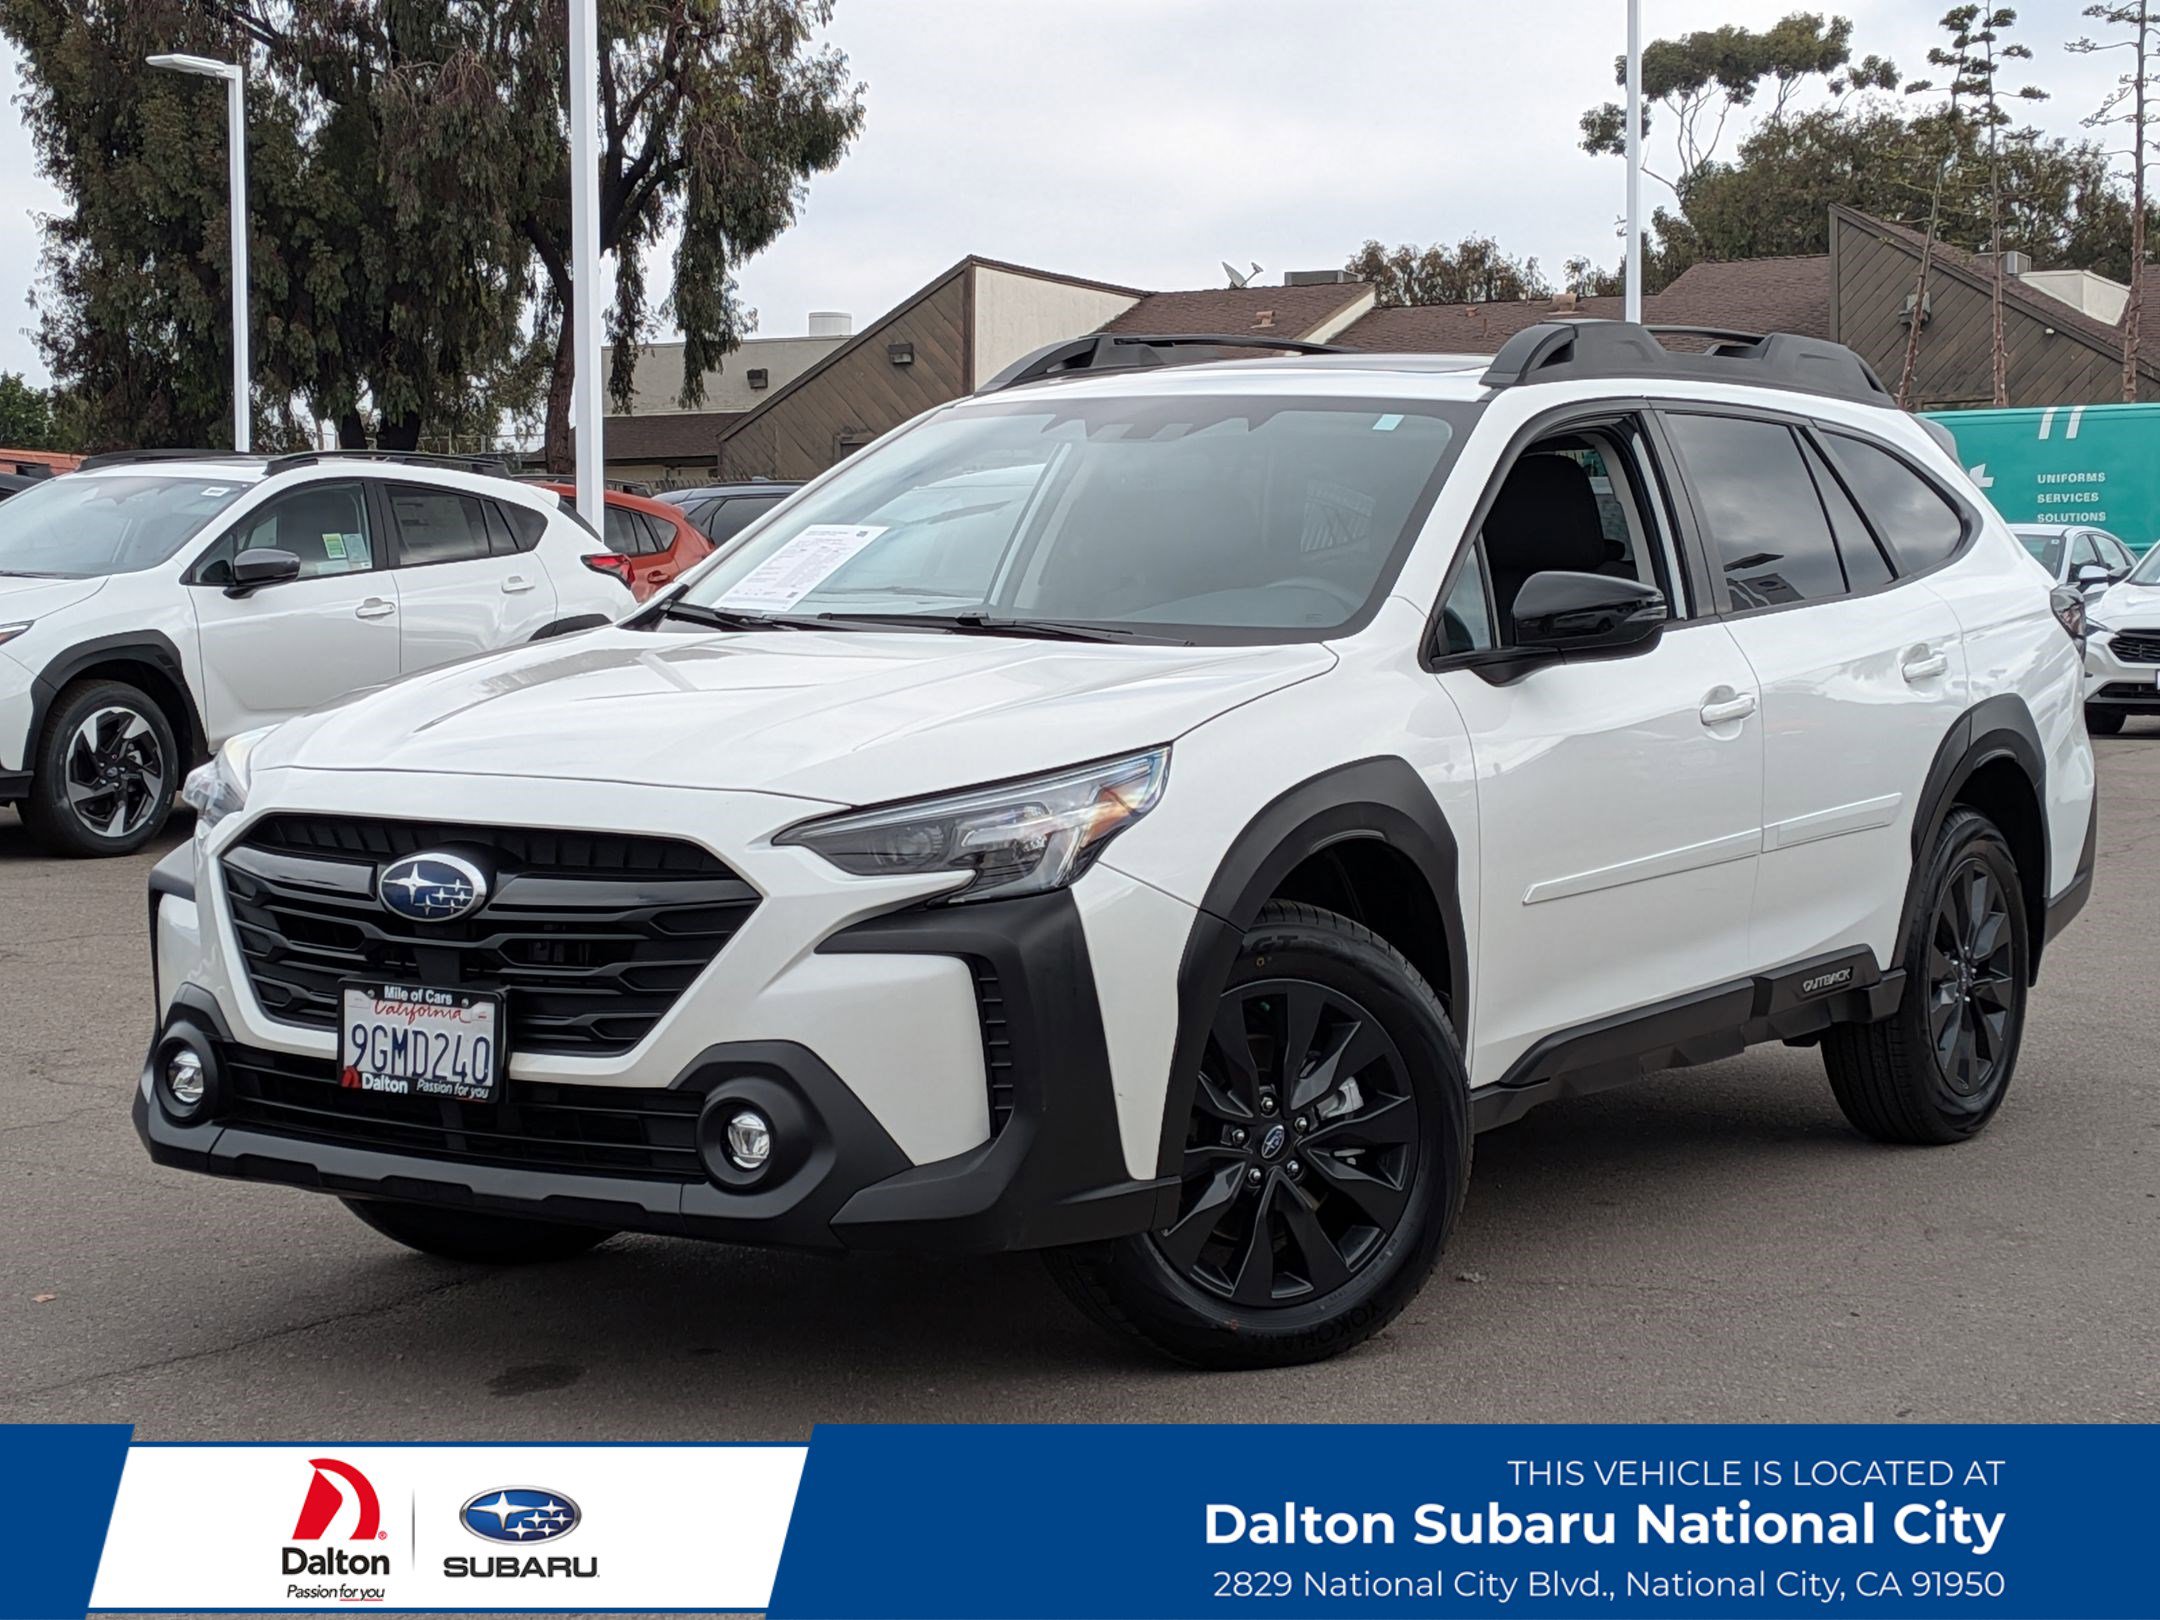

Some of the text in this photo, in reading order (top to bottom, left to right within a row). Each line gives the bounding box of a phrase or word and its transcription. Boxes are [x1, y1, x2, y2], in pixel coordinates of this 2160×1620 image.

[2037, 472, 2106, 484] UNIFORMS
[2037, 492, 2099, 503] SERVICES
[2037, 512, 2106, 523] SOLUTIONS
[1803, 968, 1851, 992] OUTBACK
[384, 985, 453, 1005] Mile of Cars
[374, 1000, 471, 1025] California
[351, 1023, 491, 1084] 9GMD240
[362, 1073, 409, 1094] Dalton
[416, 1079, 490, 1099] Passion for you
